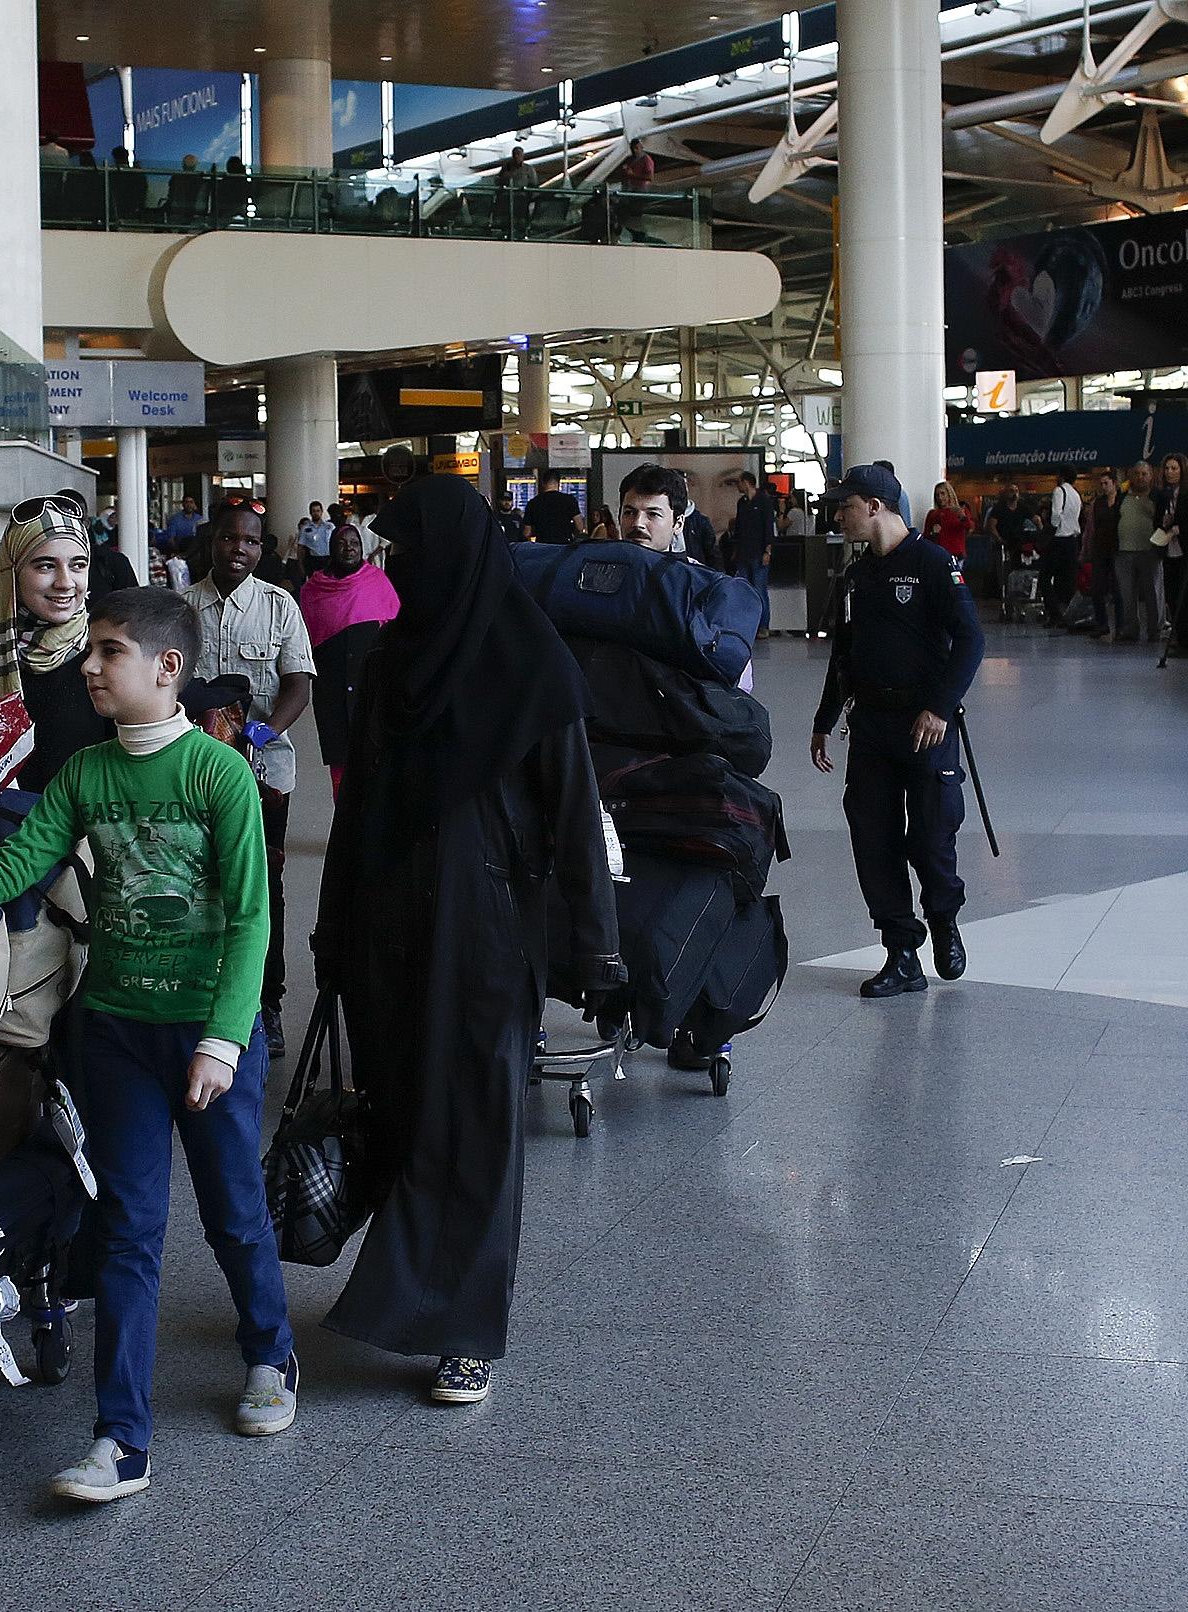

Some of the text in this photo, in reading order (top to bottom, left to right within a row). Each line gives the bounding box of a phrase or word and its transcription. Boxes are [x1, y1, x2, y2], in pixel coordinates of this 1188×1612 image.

[135, 84, 218, 133] MAIS FUNCIONAL
[49, 387, 83, 398] MENT
[128, 389, 189, 402] Welcome
[141, 403, 176, 416] Desk
[985, 446, 1098, 466] informação turística
[119, 974, 182, 992] GREAT
